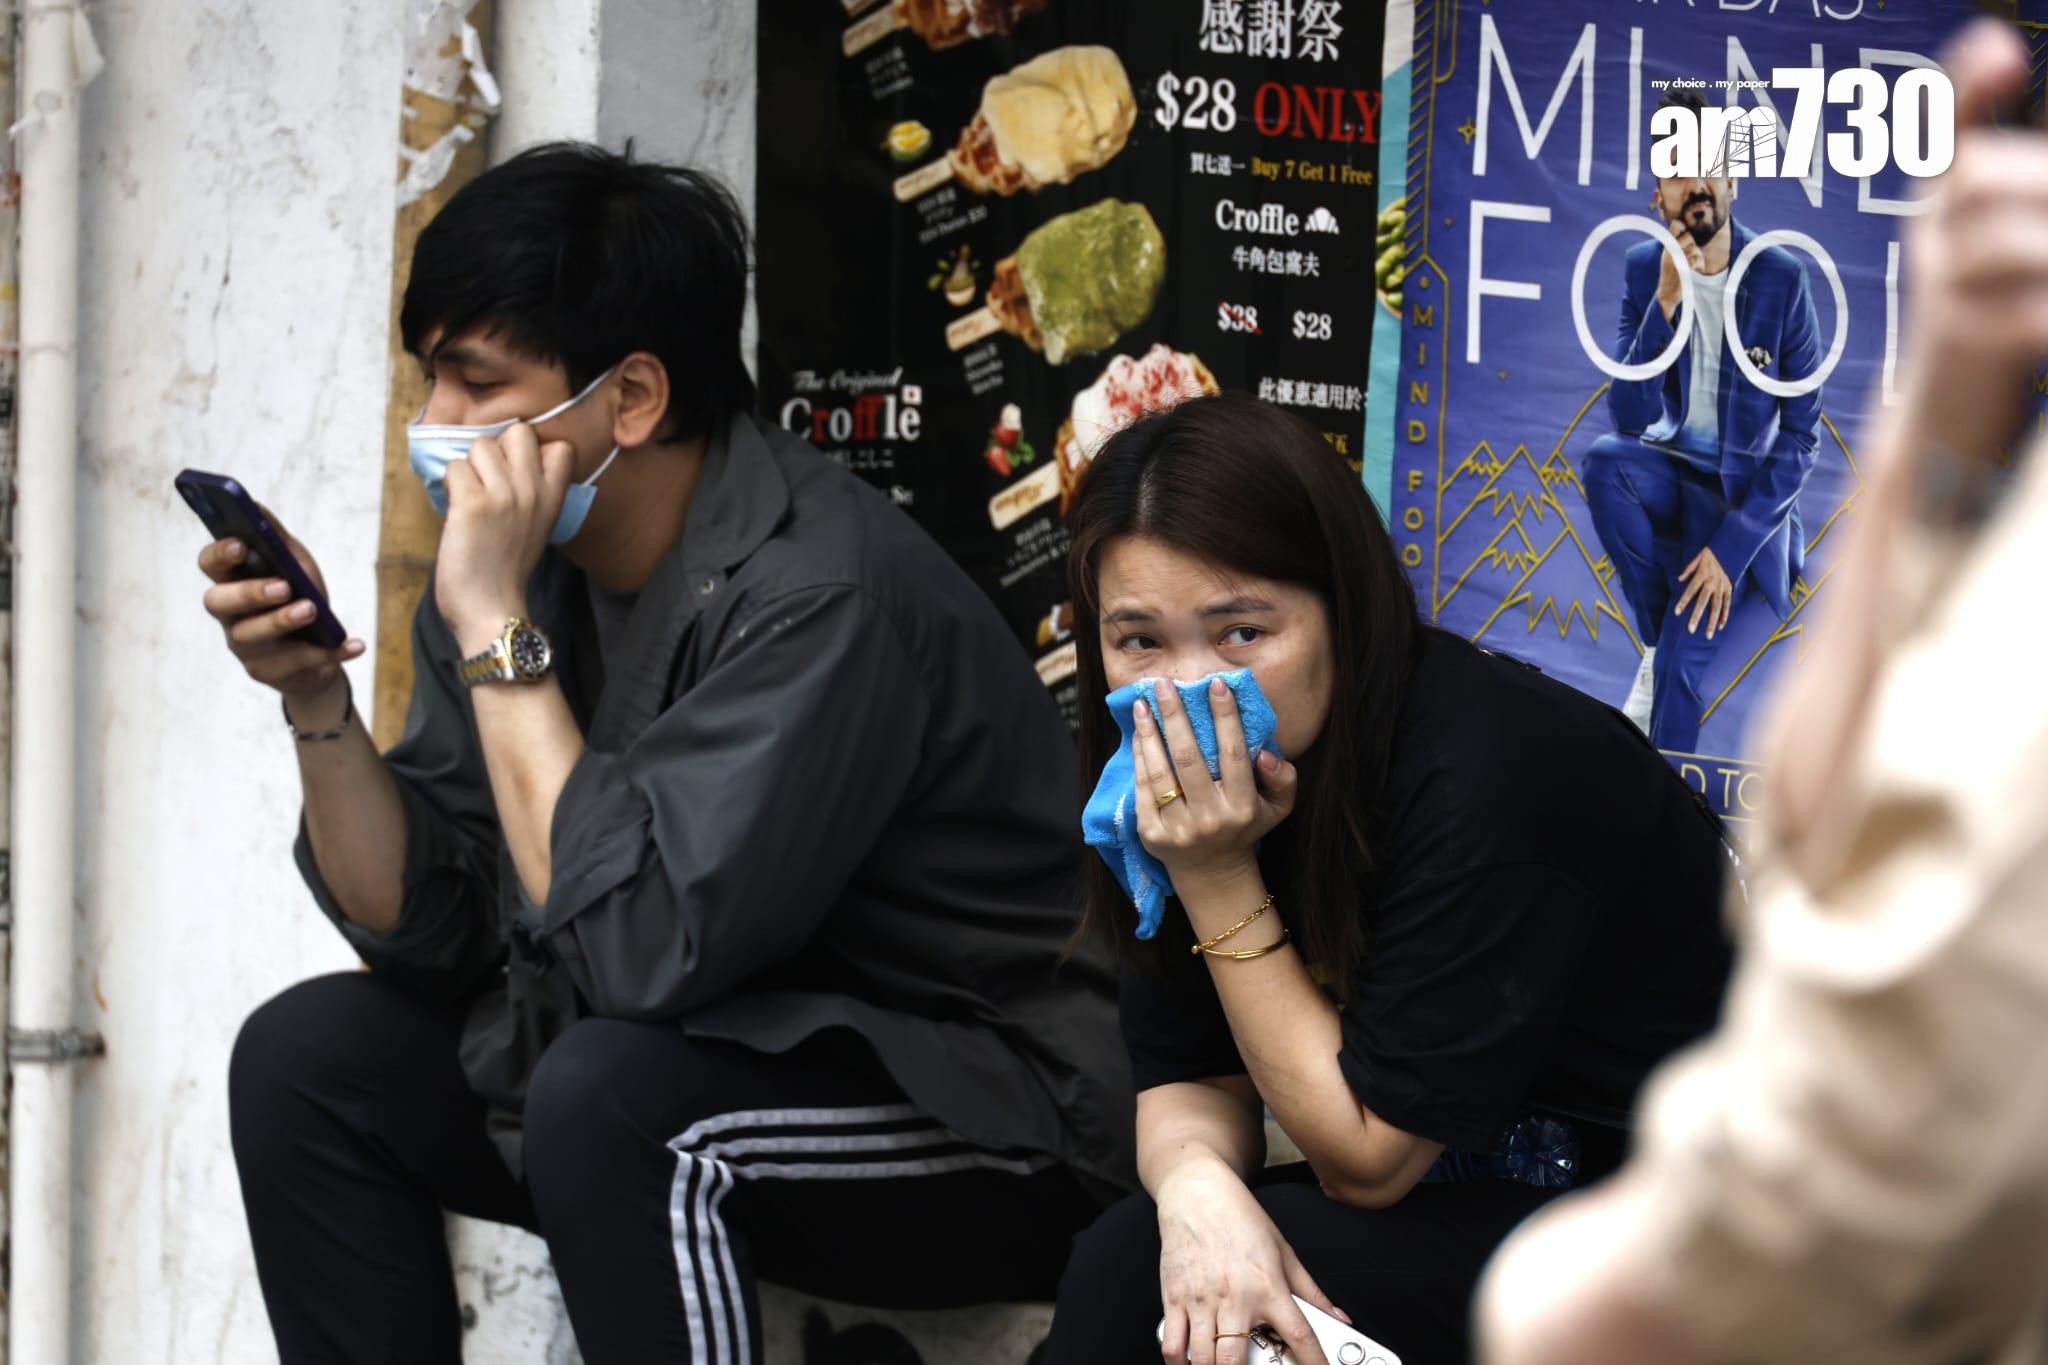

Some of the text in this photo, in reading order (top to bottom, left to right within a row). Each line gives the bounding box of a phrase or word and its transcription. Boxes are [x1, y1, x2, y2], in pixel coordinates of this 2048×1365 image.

[1200, 0, 1343, 61] 感謝祭
[1155, 71, 1382, 144] $28 ONLY
[1190, 152, 1246, 176] 買七送一
[1252, 156, 1373, 186] Buy 7 Get 1 Free
[1215, 199, 1299, 236] Croffle
[1232, 245, 1320, 277] 牛角包窩夫
[1292, 310, 1332, 340] $28
[1406, 303, 1434, 444] MIND
[780, 394, 922, 442] Croffle
